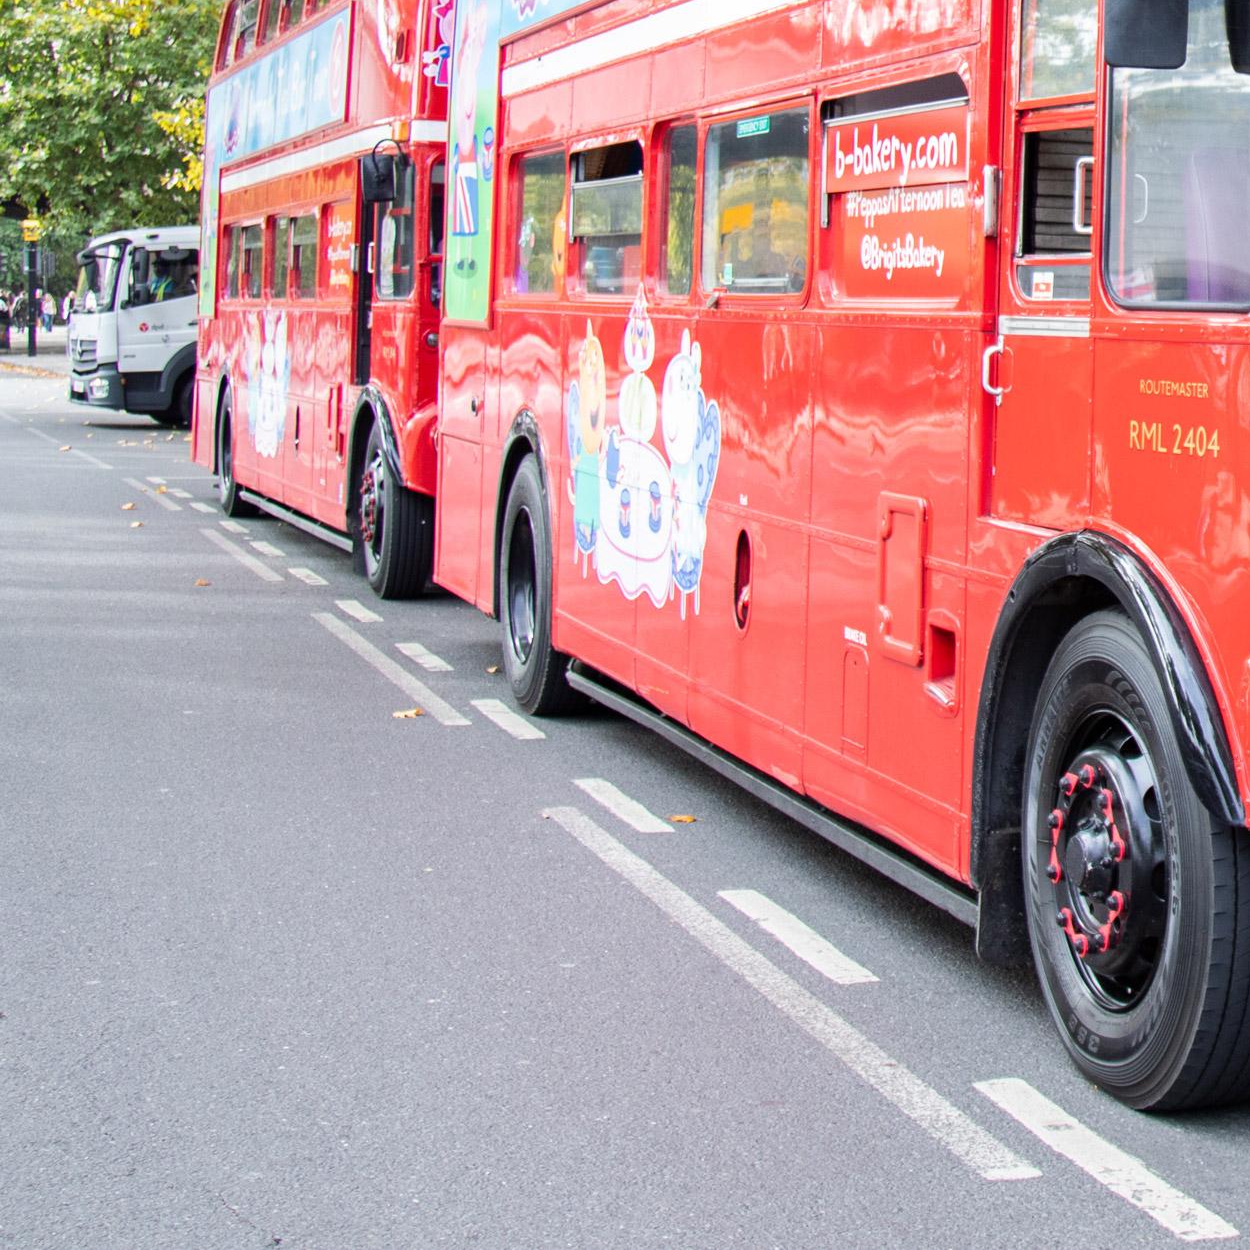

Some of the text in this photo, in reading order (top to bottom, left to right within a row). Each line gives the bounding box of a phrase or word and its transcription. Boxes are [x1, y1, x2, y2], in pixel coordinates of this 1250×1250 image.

[835, 123, 958, 185] b-bakery.com
[861, 233, 945, 280] @BrigitsBakery
[1140, 379, 1209, 398] ROUTEMASTER
[1129, 419, 1220, 458] RML 2404
